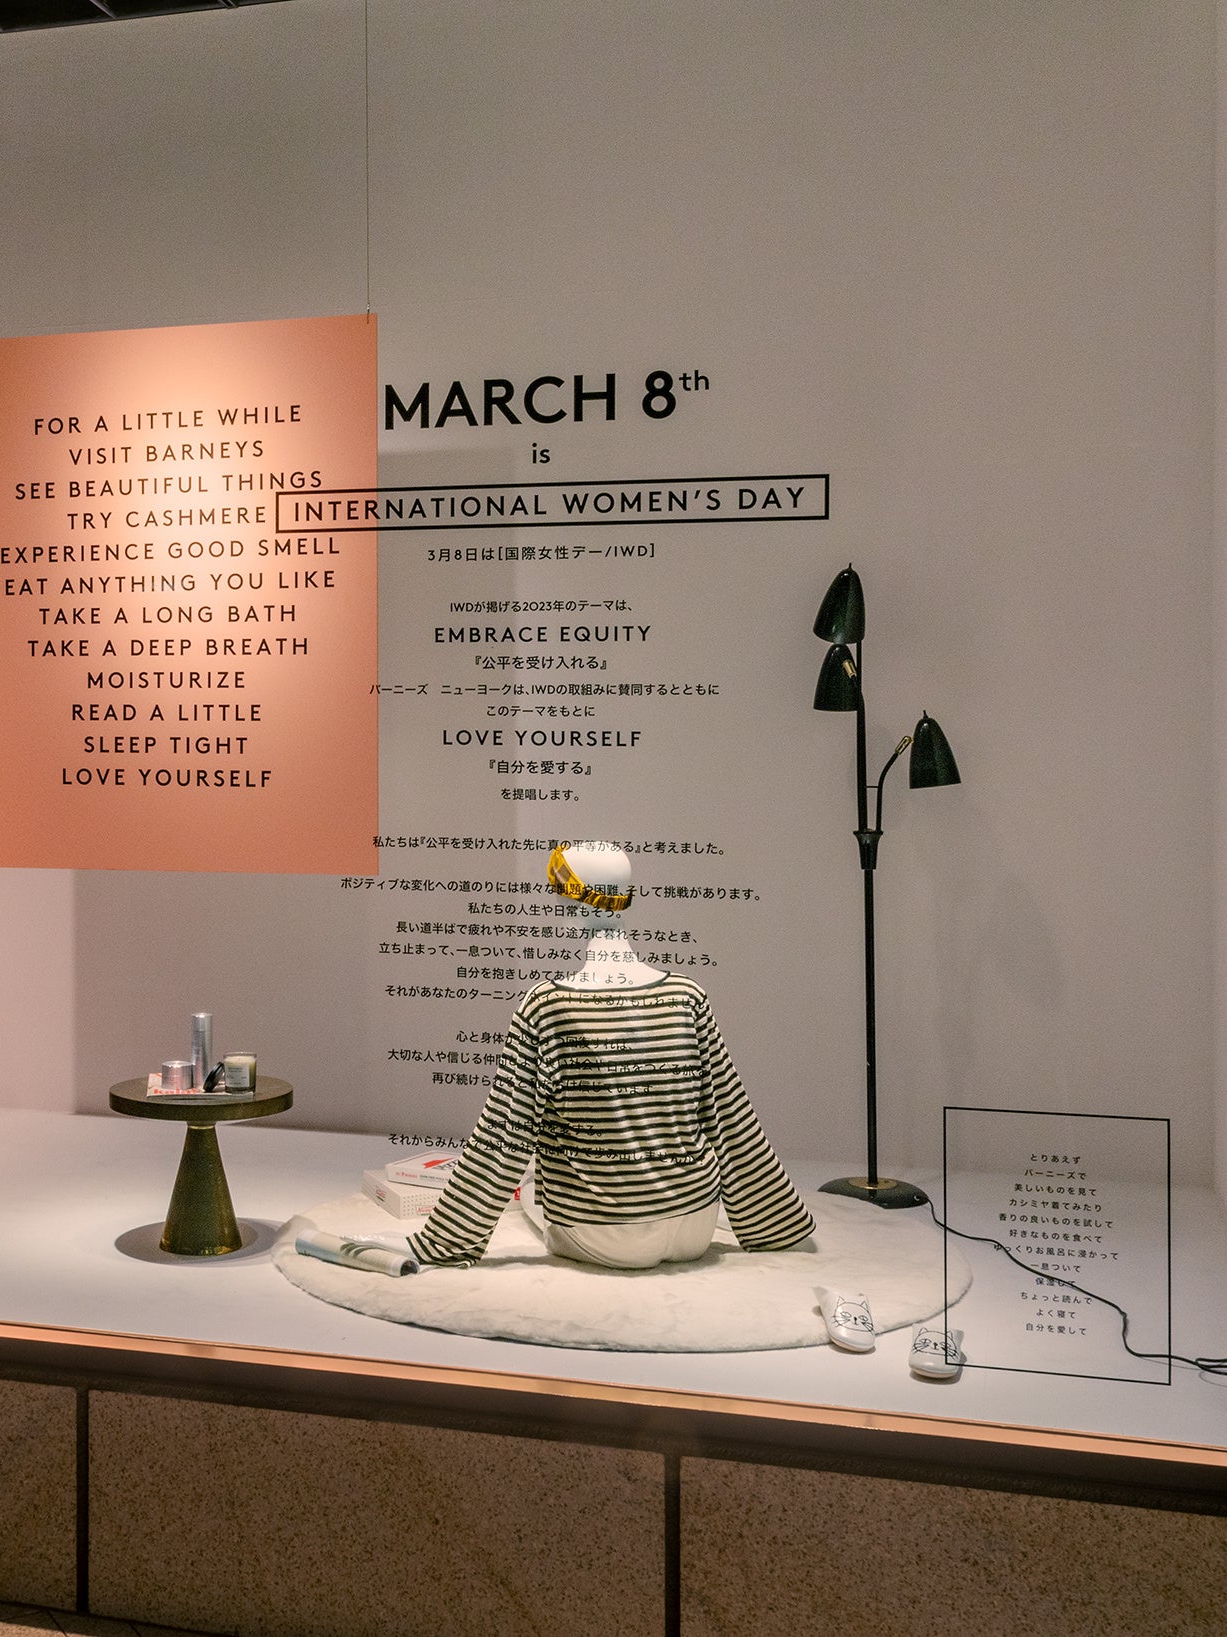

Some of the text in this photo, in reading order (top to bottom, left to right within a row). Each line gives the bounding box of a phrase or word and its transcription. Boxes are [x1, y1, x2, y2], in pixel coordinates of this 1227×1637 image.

[385, 370, 709, 430] MARCH 8th
[35, 405, 300, 435] FOR A LITTLE WHILE
[69, 440, 263, 465] VISIT BARNEYS
[532, 443, 550, 464] is
[16, 470, 323, 500] SEE BEAUTIFUL THINGS
[294, 495, 547, 522] INTERNATIONAL
[738, 487, 805, 509] DAY
[67, 506, 265, 529] TRY CASHMERE
[1, 537, 339, 564] EXPERIENCE GOOD SMELL
[5, 571, 334, 595] EAT ANYTHING YOU LIKE
[39, 605, 295, 624] TAKE A LONG BATH
[450, 600, 632, 613] IWDが掲げる2023年のテーマは、
[435, 626, 650, 643] EMBRACE EQUITY
[28, 638, 307, 656] TAKE A DEEP BREATH
[475, 656, 606, 670] 『公平を受け入れる』
[88, 672, 244, 688] MOISTURIZE
[369, 684, 427, 696] バーニーズ
[72, 704, 261, 721] READ A LITTLE
[487, 705, 595, 717] このテーマをもとに
[84, 736, 247, 754] SLEEP TIGHT
[443, 730, 641, 746] LOVE YOURSELF
[490, 759, 591, 775] 『自分を愛する』
[63, 768, 271, 787] LOVE YOURSELF
[501, 788, 579, 801] を提唱します。
[1030, 1154, 1080, 1164] とりあえず
[1024, 1169, 1086, 1180] バーニーズで
[1015, 1183, 1096, 1196] 美しいものを見て
[1010, 1199, 1101, 1212] カシミヤ着てみたり
[999, 1213, 1113, 1228] 香りの良いものを試して
[1010, 1229, 1101, 1243] 好きなものを食べて
[1021, 1292, 1092, 1305] ちょっと読んで
[1037, 1309, 1075, 1318] よく寝て
[1026, 1323, 1086, 1335] 自分を愛して
